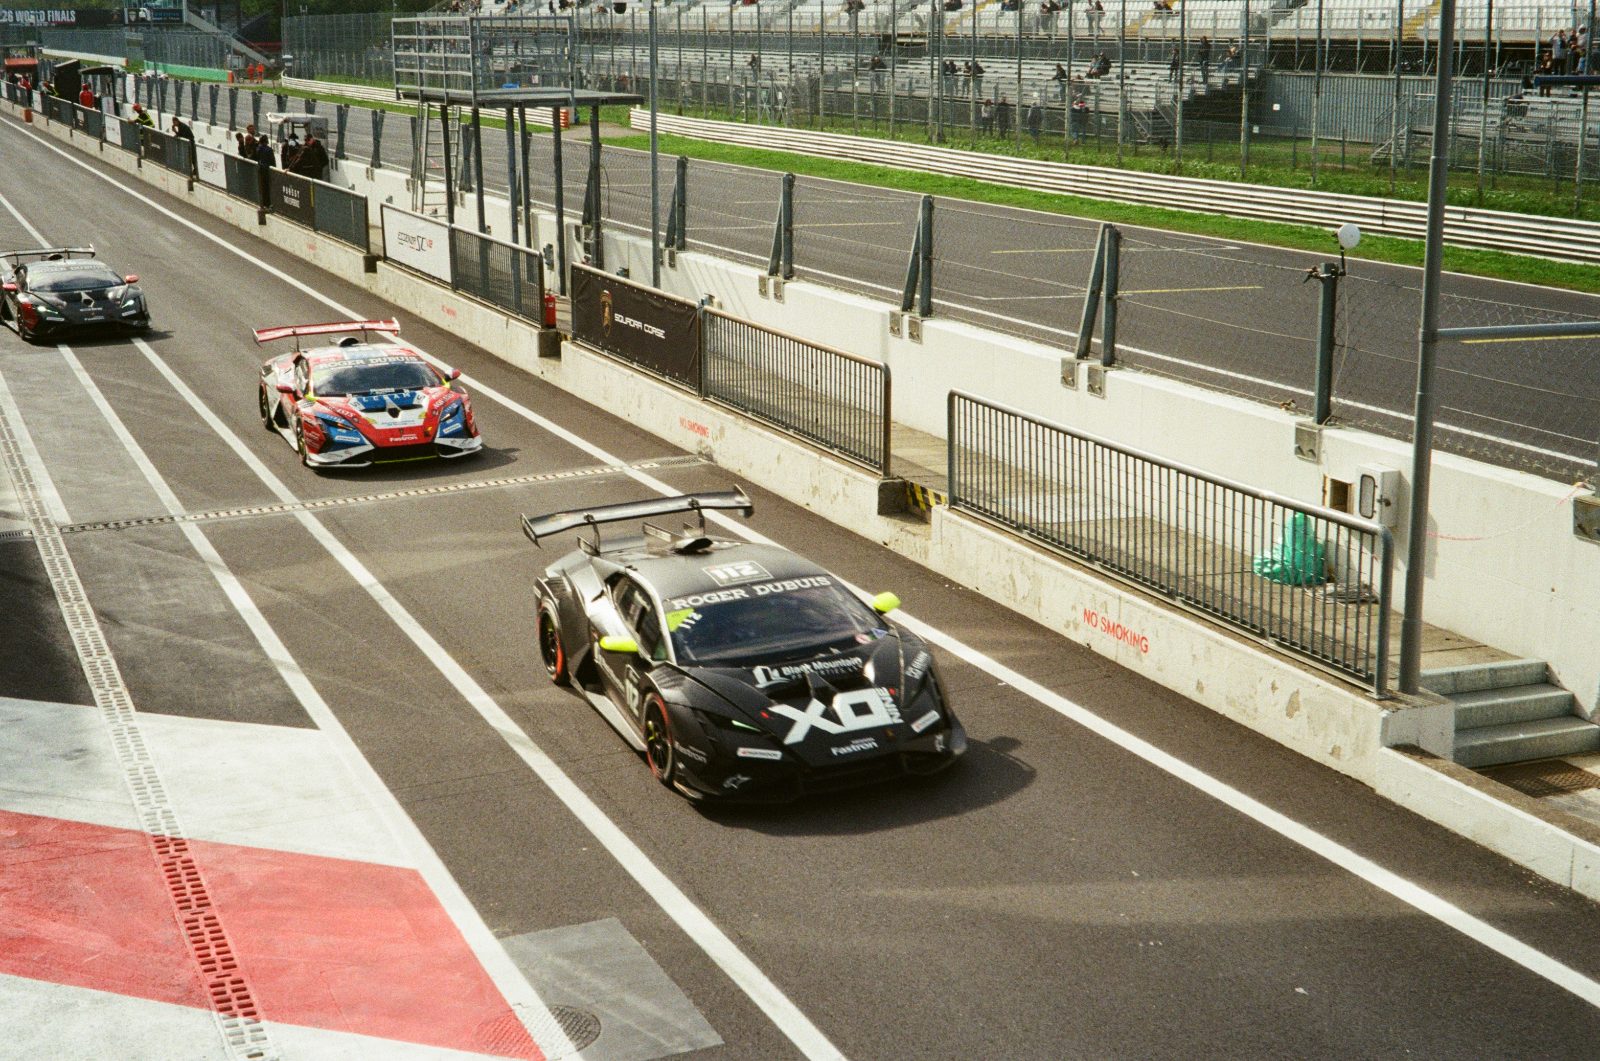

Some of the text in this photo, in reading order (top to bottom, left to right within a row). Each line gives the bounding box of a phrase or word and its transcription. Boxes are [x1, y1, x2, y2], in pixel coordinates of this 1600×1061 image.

[48, 10, 76, 22] FINALS
[614, 313, 666, 339] SQUADRA CORSE
[710, 564, 760, 579] 112
[671, 575, 832, 610] ROGER DUBUIS
[1083, 608, 1149, 653] NO SMOKING
[811, 656, 863, 670] Mountain
[830, 741, 879, 756] Fastron
